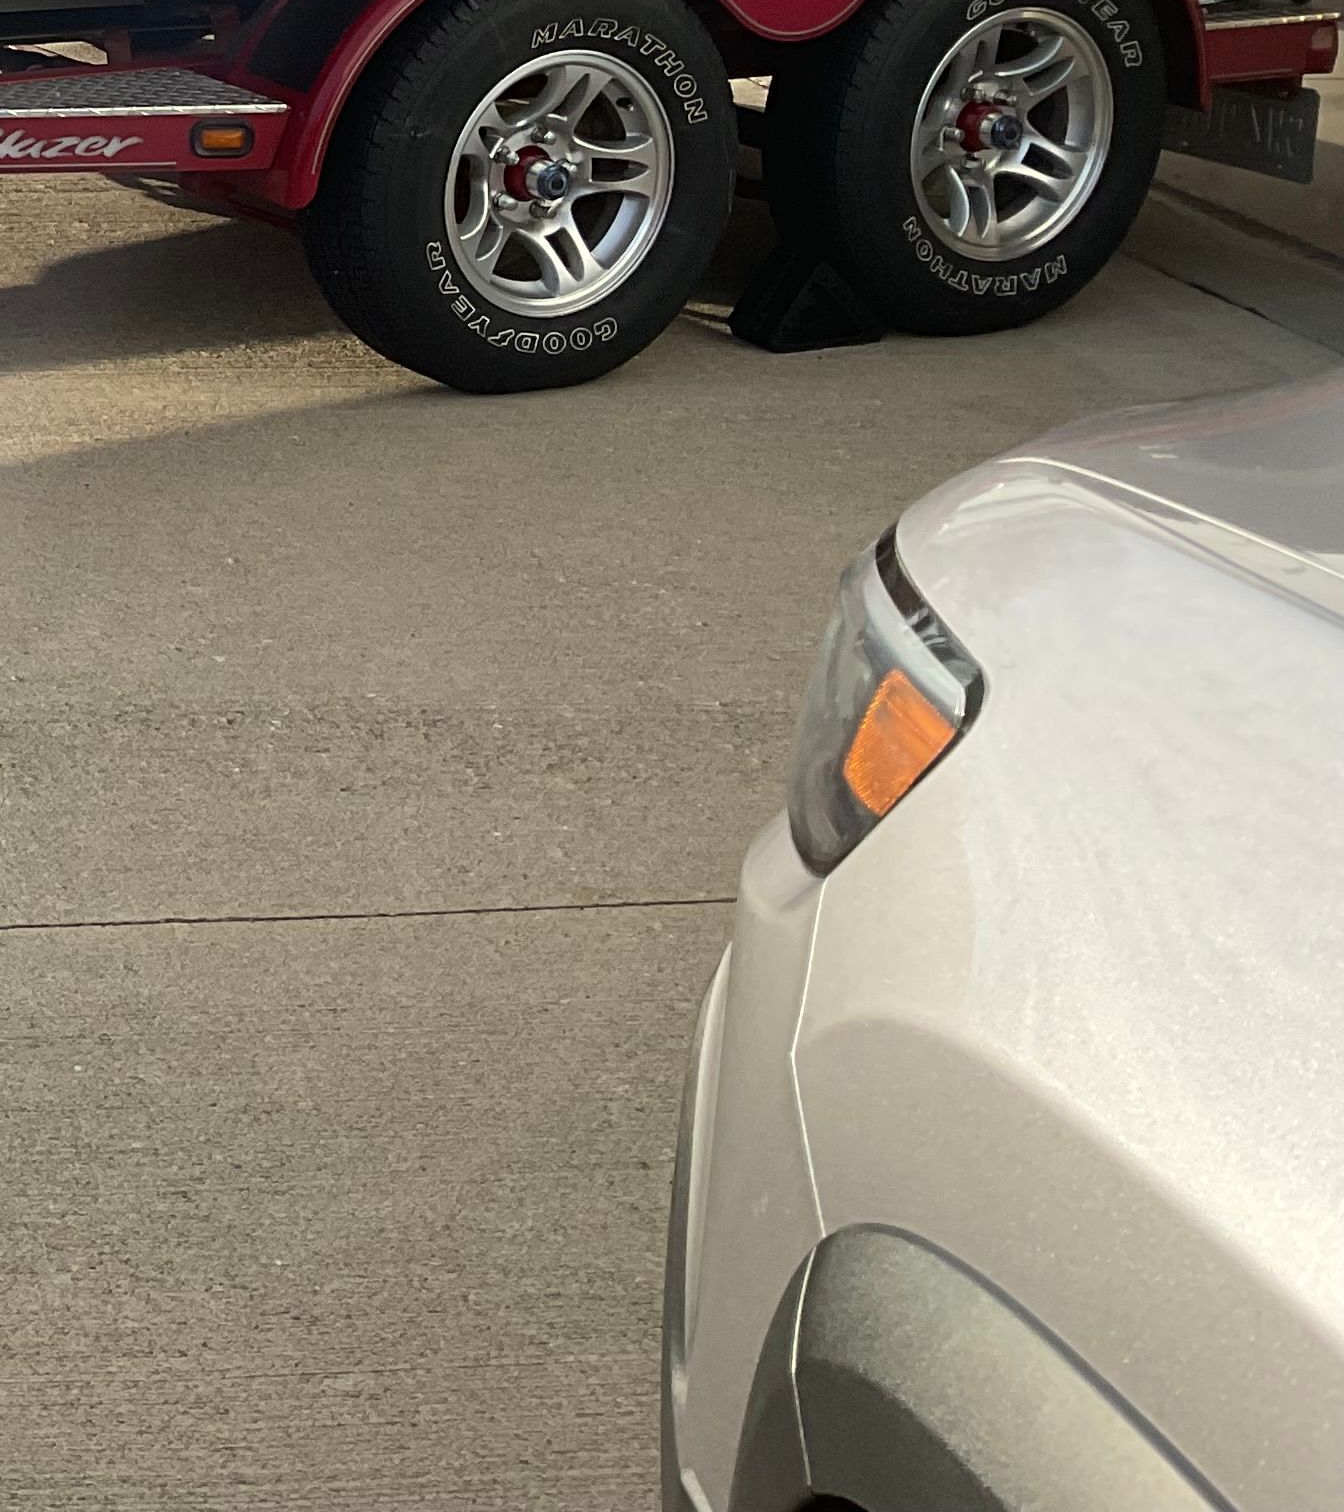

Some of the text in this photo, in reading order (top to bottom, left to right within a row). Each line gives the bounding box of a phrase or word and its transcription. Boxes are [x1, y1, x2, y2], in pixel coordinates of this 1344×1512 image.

[531, 18, 708, 124] MARATHON
[425, 241, 618, 354] GOODYEAR
[902, 216, 1068, 296] MARATHON
